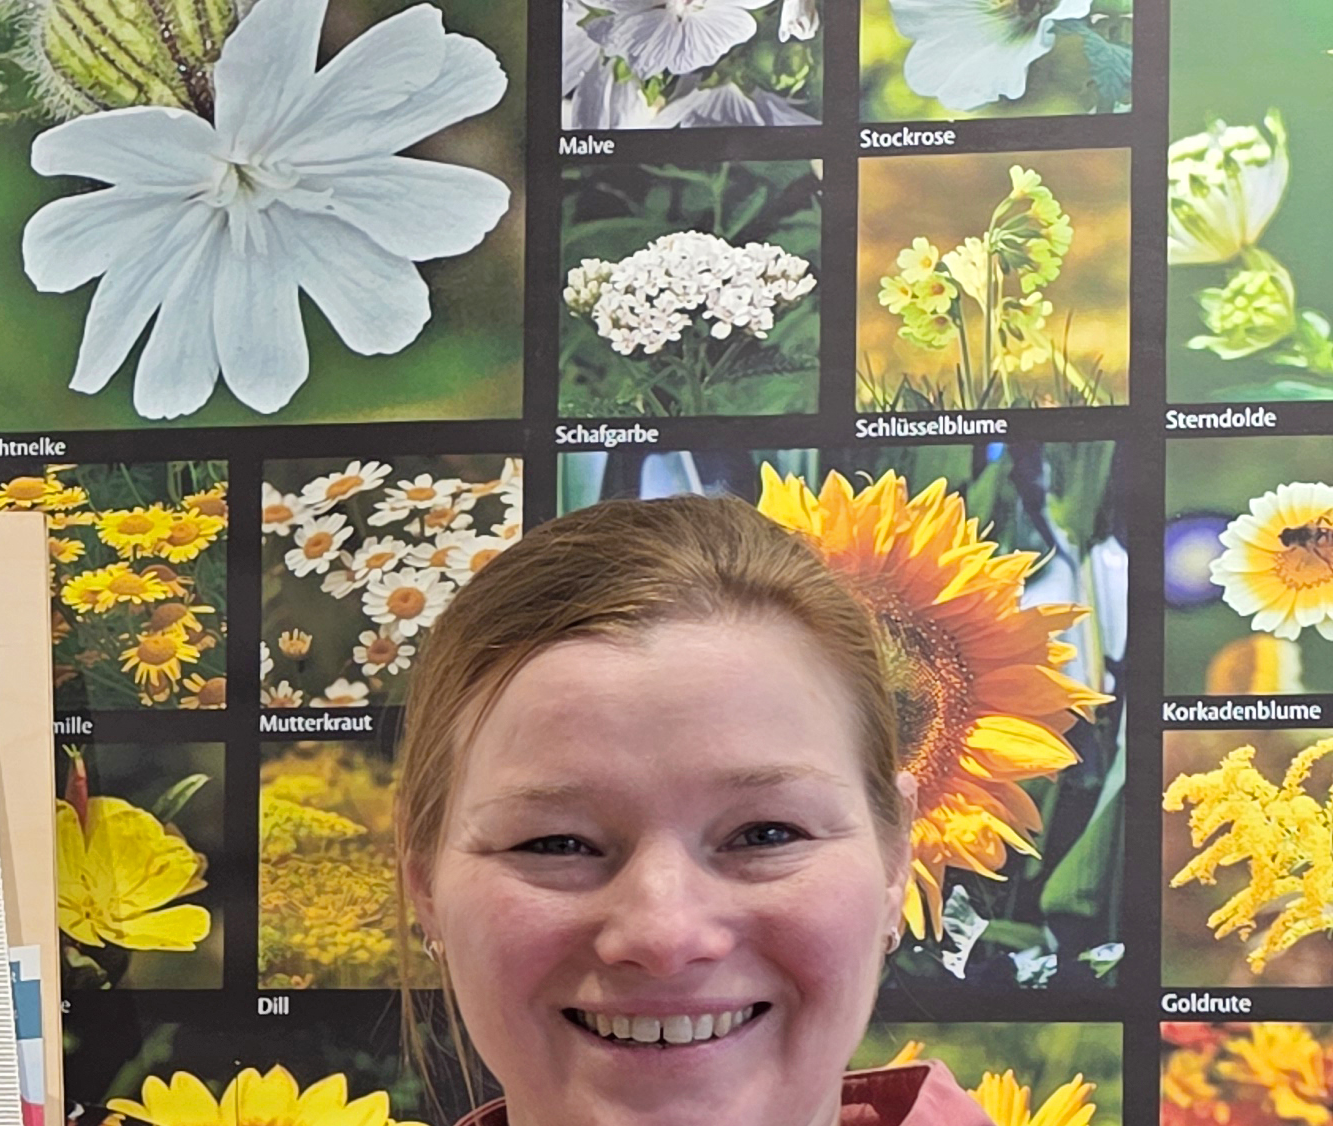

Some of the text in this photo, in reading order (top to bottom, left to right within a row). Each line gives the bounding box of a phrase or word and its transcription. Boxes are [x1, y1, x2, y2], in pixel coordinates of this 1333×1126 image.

[558, 134, 615, 155] Malve
[860, 126, 956, 149] Stockrose
[855, 414, 1008, 438] Schlüsselblume
[1165, 406, 1277, 429] Sterndolde
[555, 423, 659, 448] Schafgarbe
[1162, 698, 1322, 721] Korkadenblume
[259, 713, 373, 732] Mutterkraut
[257, 996, 290, 1016] Dill
[1161, 992, 1252, 1013] Goldrute
